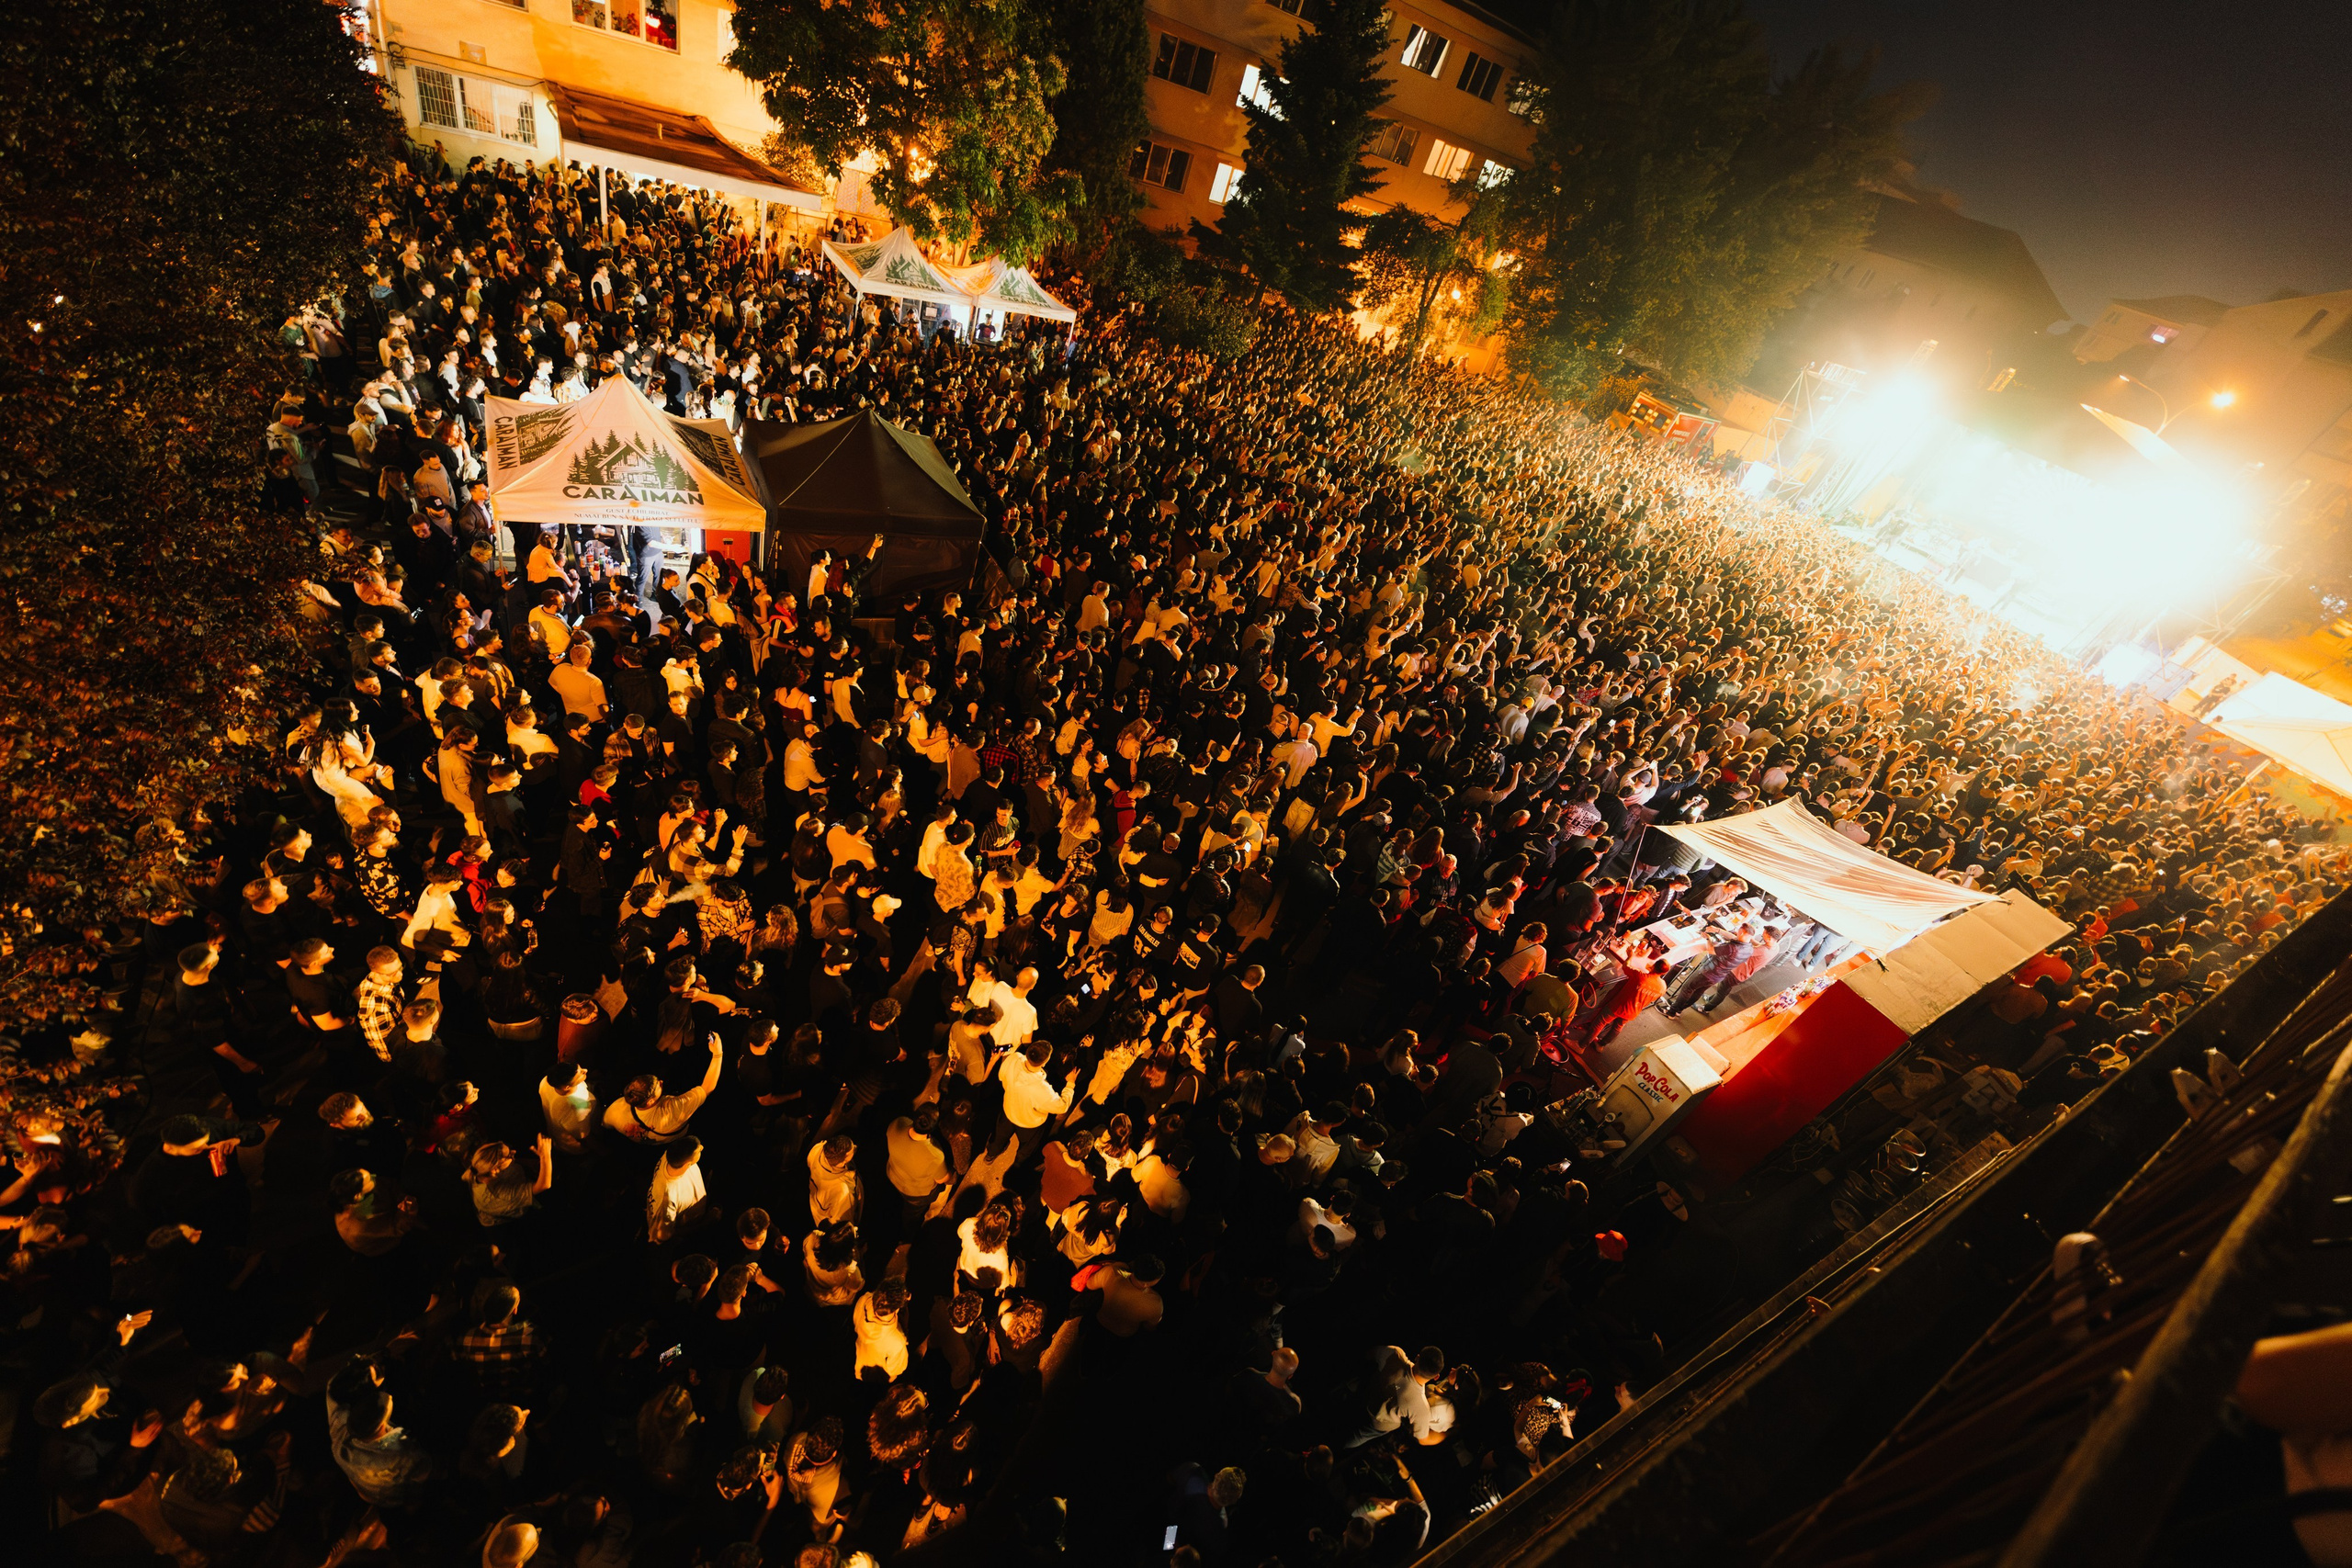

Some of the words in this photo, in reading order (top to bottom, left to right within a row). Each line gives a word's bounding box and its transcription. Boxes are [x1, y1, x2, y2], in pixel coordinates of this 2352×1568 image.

[886, 277, 945, 293] CARAIMAN
[1001, 295, 1053, 309] CARAIMAN
[494, 416, 519, 470] CARAIMAN
[711, 434, 745, 486] CARAIMAN
[561, 484, 705, 505] CARAIMAN
[1637, 1082, 1664, 1103] CLASSIC
